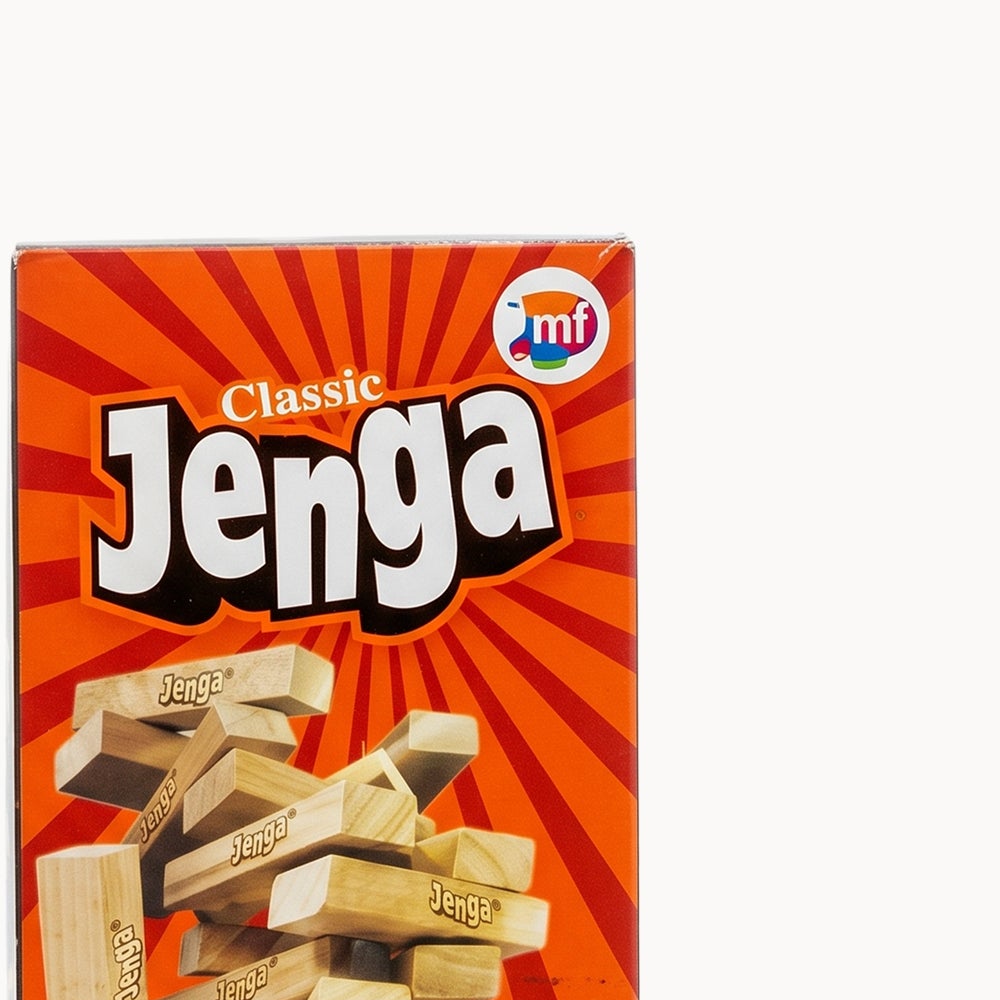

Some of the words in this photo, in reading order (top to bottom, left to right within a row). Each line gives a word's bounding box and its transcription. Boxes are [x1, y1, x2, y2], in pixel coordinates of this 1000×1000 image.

[533, 301, 589, 344] mf
[221, 369, 383, 423] Classic
[95, 388, 557, 614] Jenga
